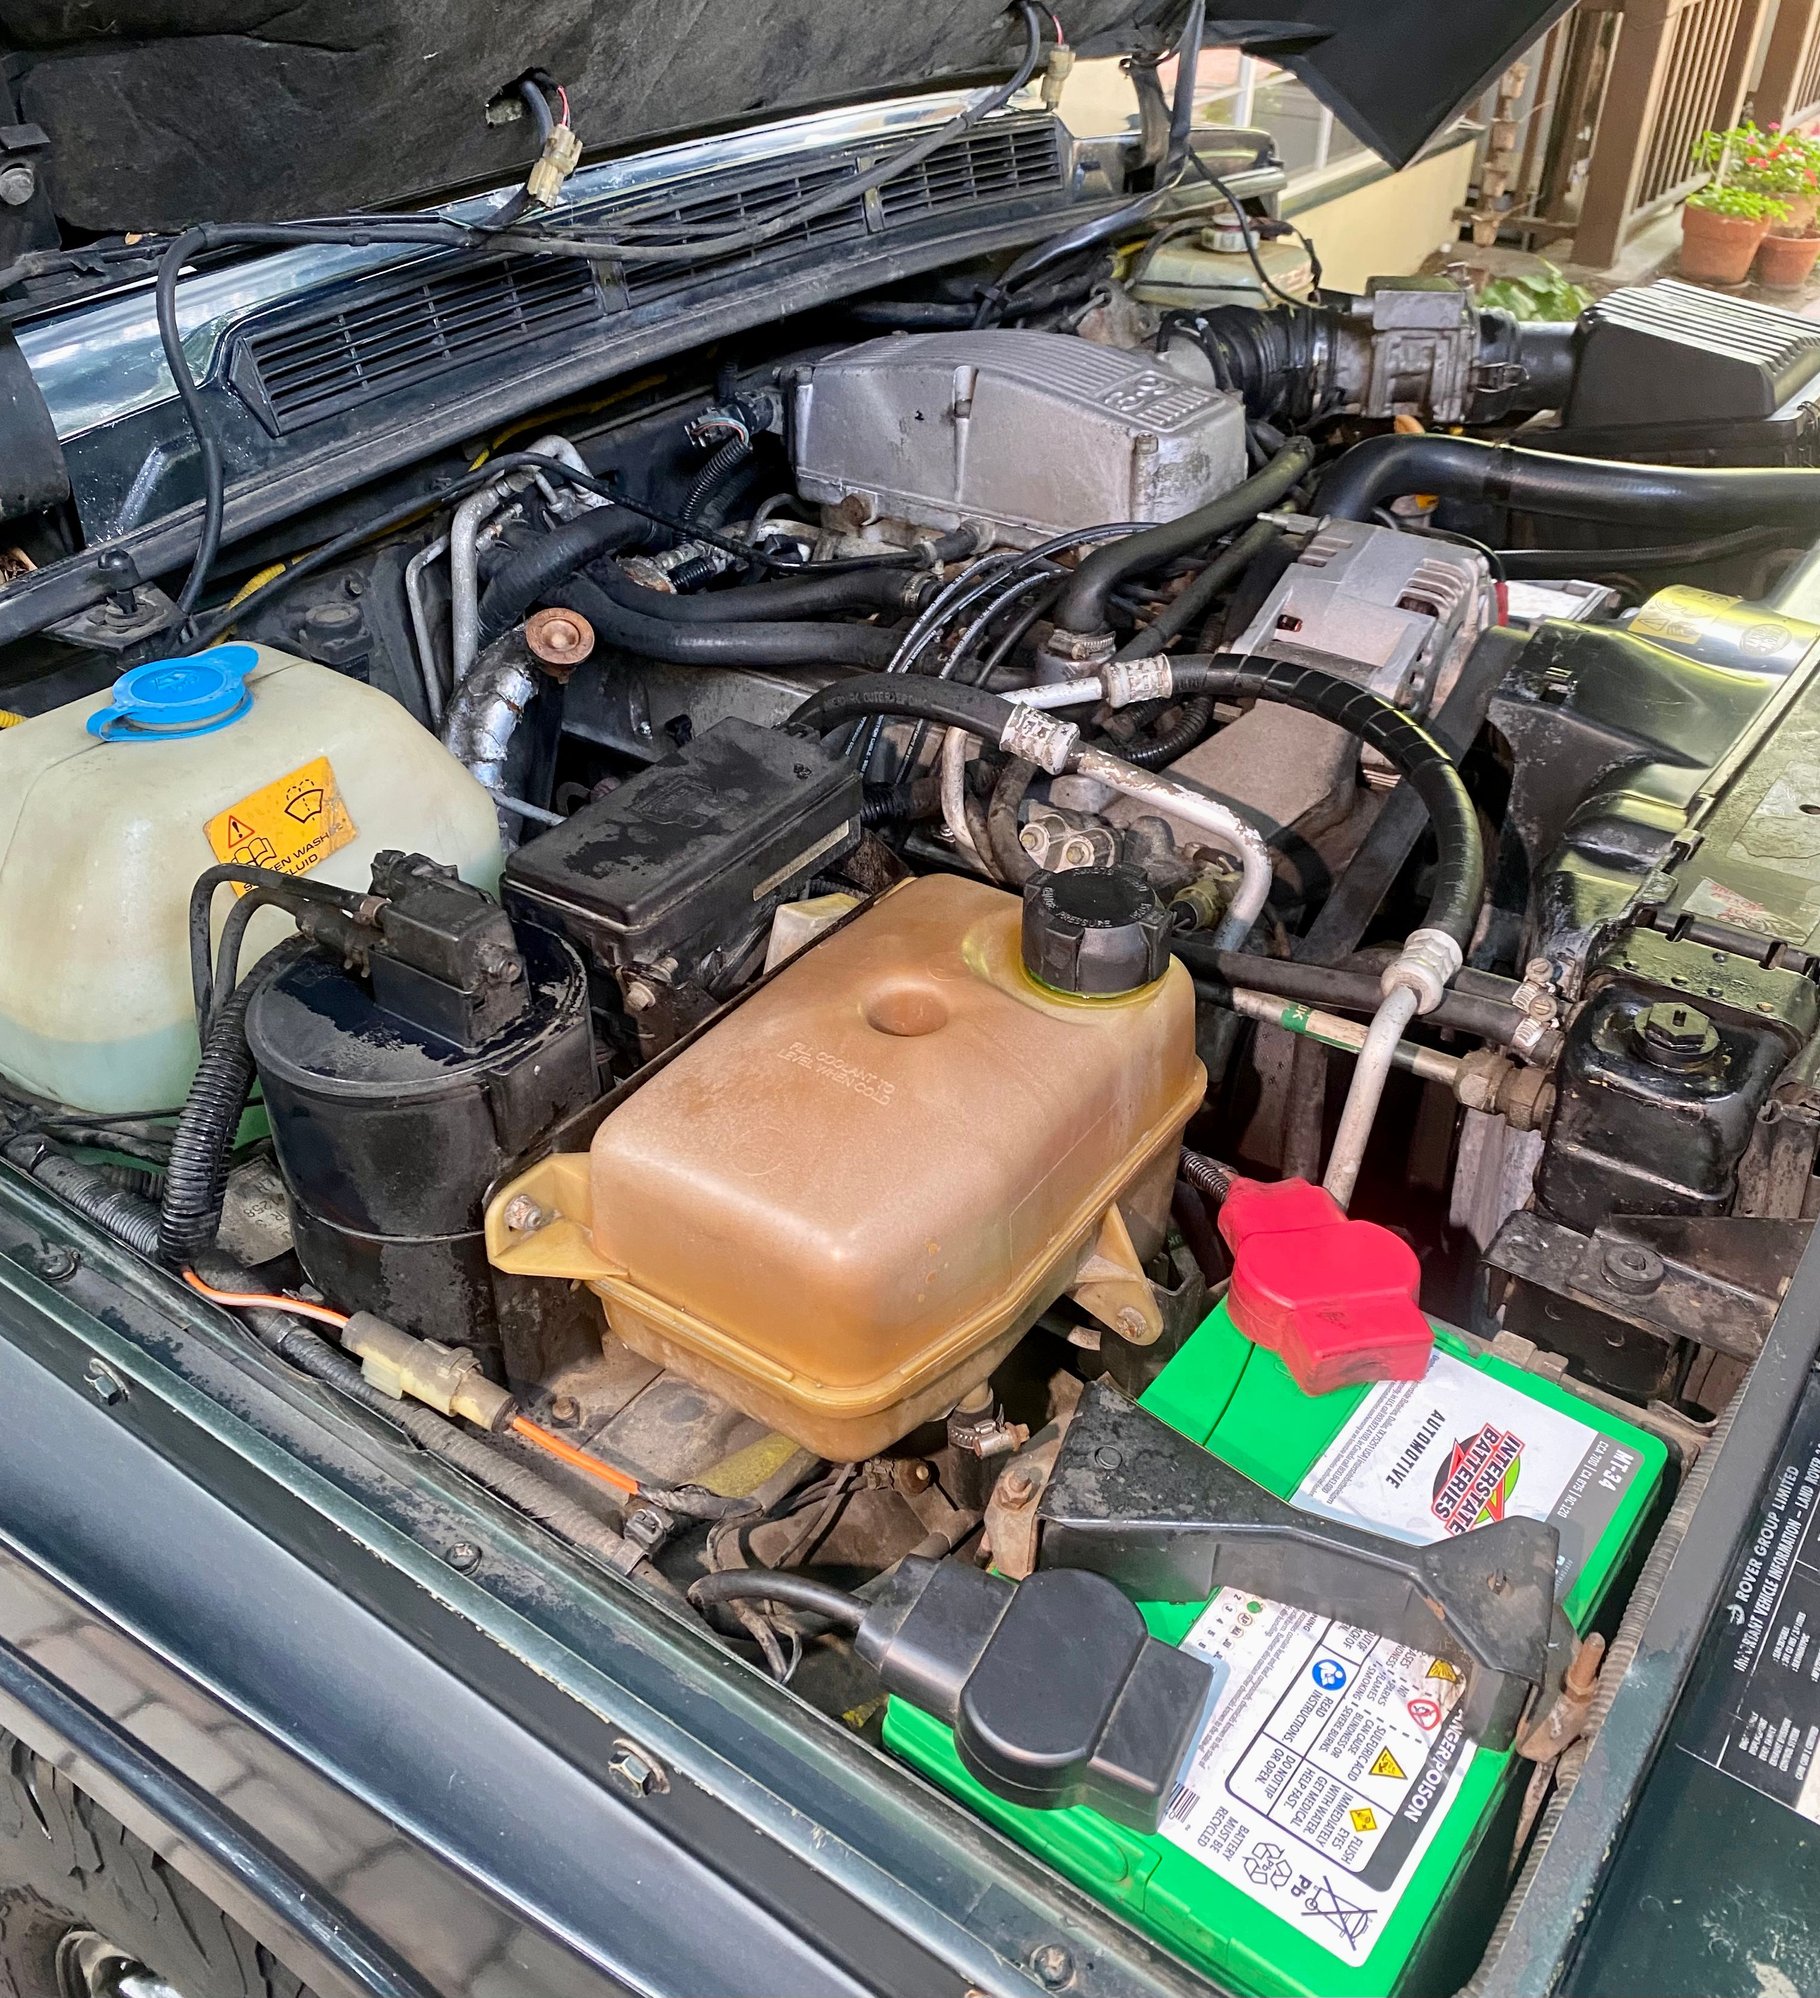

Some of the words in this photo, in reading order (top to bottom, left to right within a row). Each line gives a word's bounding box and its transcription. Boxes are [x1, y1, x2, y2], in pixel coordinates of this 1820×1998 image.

[1292, 1004, 1310, 1021] UK
[777, 1048, 814, 1070] LEVEL
[816, 1063, 855, 1088] WHEN
[854, 1082, 891, 1106] COLD
[789, 1041, 813, 1057] FILL
[816, 1051, 878, 1083] COOLANT
[878, 1078, 896, 1094] TO
[1384, 1408, 1446, 1489] AUTOMOTIVE
[1587, 1452, 1601, 1466] 700
[1594, 1440, 1608, 1454] CCA
[1431, 1427, 1501, 1520] BATTERIES
[1579, 1468, 1591, 1480] CA
[1597, 1448, 1634, 1492] MT-34
[1447, 1435, 1521, 1537] INTERSTATE
[1556, 1503, 1571, 1518] 120
[1564, 1494, 1576, 1505] RC
[1734, 1557, 1763, 1603] ROVER
[1752, 1509, 1783, 1558] GROUP
[1771, 1464, 1800, 1511] LIMITED
[1752, 1578, 1779, 1617] VEHICLE
[1766, 1518, 1802, 1581] INFORMATION
[1794, 1484, 1815, 1510] LAND
[1302, 1612, 1318, 1632] NING
[1341, 1637, 1354, 1649] OF
[1355, 1640, 1368, 1652] OF
[1384, 1641, 1405, 1668] NDNESS
[1351, 1665, 1376, 1701] SMOKING
[1396, 1684, 1410, 1698] NO
[1281, 1688, 1323, 1744] INSTRUCTIONS.
[1314, 1695, 1333, 1718] READ
[1332, 1704, 1353, 1730] SEVERE
[1335, 1711, 1363, 1749] BLINDNESS
[1359, 1718, 1374, 1735] CAN
[1318, 1727, 1339, 1753] BURNS.
[1329, 1745, 1342, 1759] OR
[1347, 1731, 1366, 1755] CAUSE
[1357, 1724, 1386, 1763] SULFURIC
[1269, 1747, 1285, 1762] OR
[1280, 1754, 1296, 1770] DO
[1254, 1759, 1276, 1786] OPEN.
[1270, 1767, 1287, 1786] NOT
[1295, 1767, 1315, 1790] HELP
[1345, 1759, 1365, 1782] ACID
[1261, 1781, 1278, 1799] TIP
[1311, 1774, 1328, 1793] GET
[1320, 1783, 1341, 1807] WITH
[1283, 1787, 1303, 1810] FAST.
[1289, 1789, 1319, 1828] MEDICAL
[1195, 1805, 1229, 1848] RECYCLED
[1216, 1816, 1238, 1842] MUST
[1302, 1804, 1328, 1836] WATER.
[1313, 1791, 1354, 1847] IMMEDIATELY
[1209, 1839, 1224, 1853] BE
[1220, 1824, 1250, 1861] BATTERY
[1330, 1827, 1350, 1850] EYES
[1340, 1835, 1363, 1864] FLUSH
[1260, 1858, 1274, 1872] Pb
[1288, 1874, 1313, 1900] Pb
